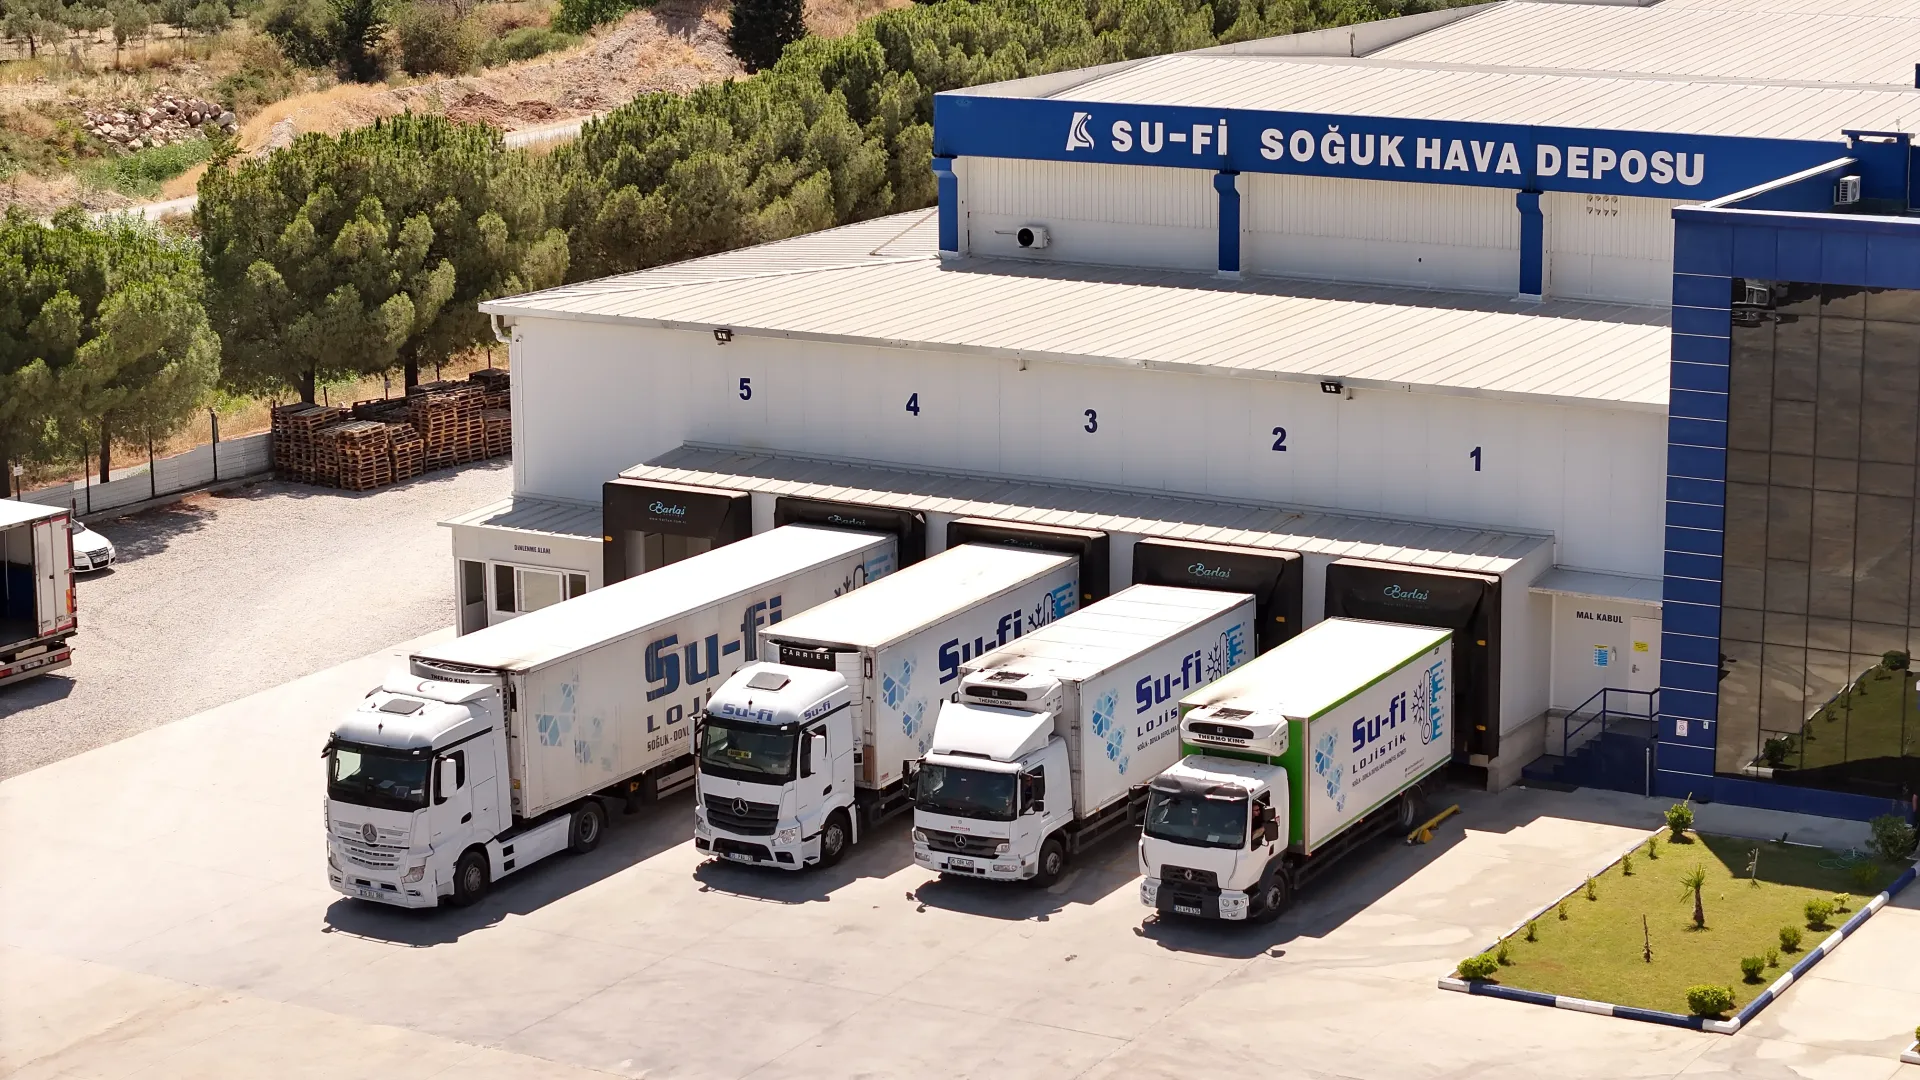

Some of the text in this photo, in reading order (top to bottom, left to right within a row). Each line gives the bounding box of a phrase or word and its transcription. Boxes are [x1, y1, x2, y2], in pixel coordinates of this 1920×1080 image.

[1111, 118, 1705, 186] SU-Fİ SOĞUK HAVA DEPOSU
[739, 377, 752, 401] 5
[905, 392, 920, 416] 4
[1084, 408, 1098, 433] 3
[1271, 426, 1287, 452] 2
[1469, 446, 1482, 472] 1
[1576, 611, 1624, 624] MAL KABUL
[782, 648, 830, 660] CARRIER
[430, 673, 454, 682] THERMO
[1135, 650, 1203, 715] Su-fi
[647, 687, 711, 734] LOJİ
[722, 702, 773, 722] Su-fi
[804, 700, 831, 720] Su-fi
[1137, 707, 1178, 738] LOJİS
[1352, 691, 1406, 754] Su-fi
[647, 734, 670, 752] SOĞUK
[1198, 733, 1227, 742] THERMO
[1352, 732, 1407, 774] LOJİSTİK
